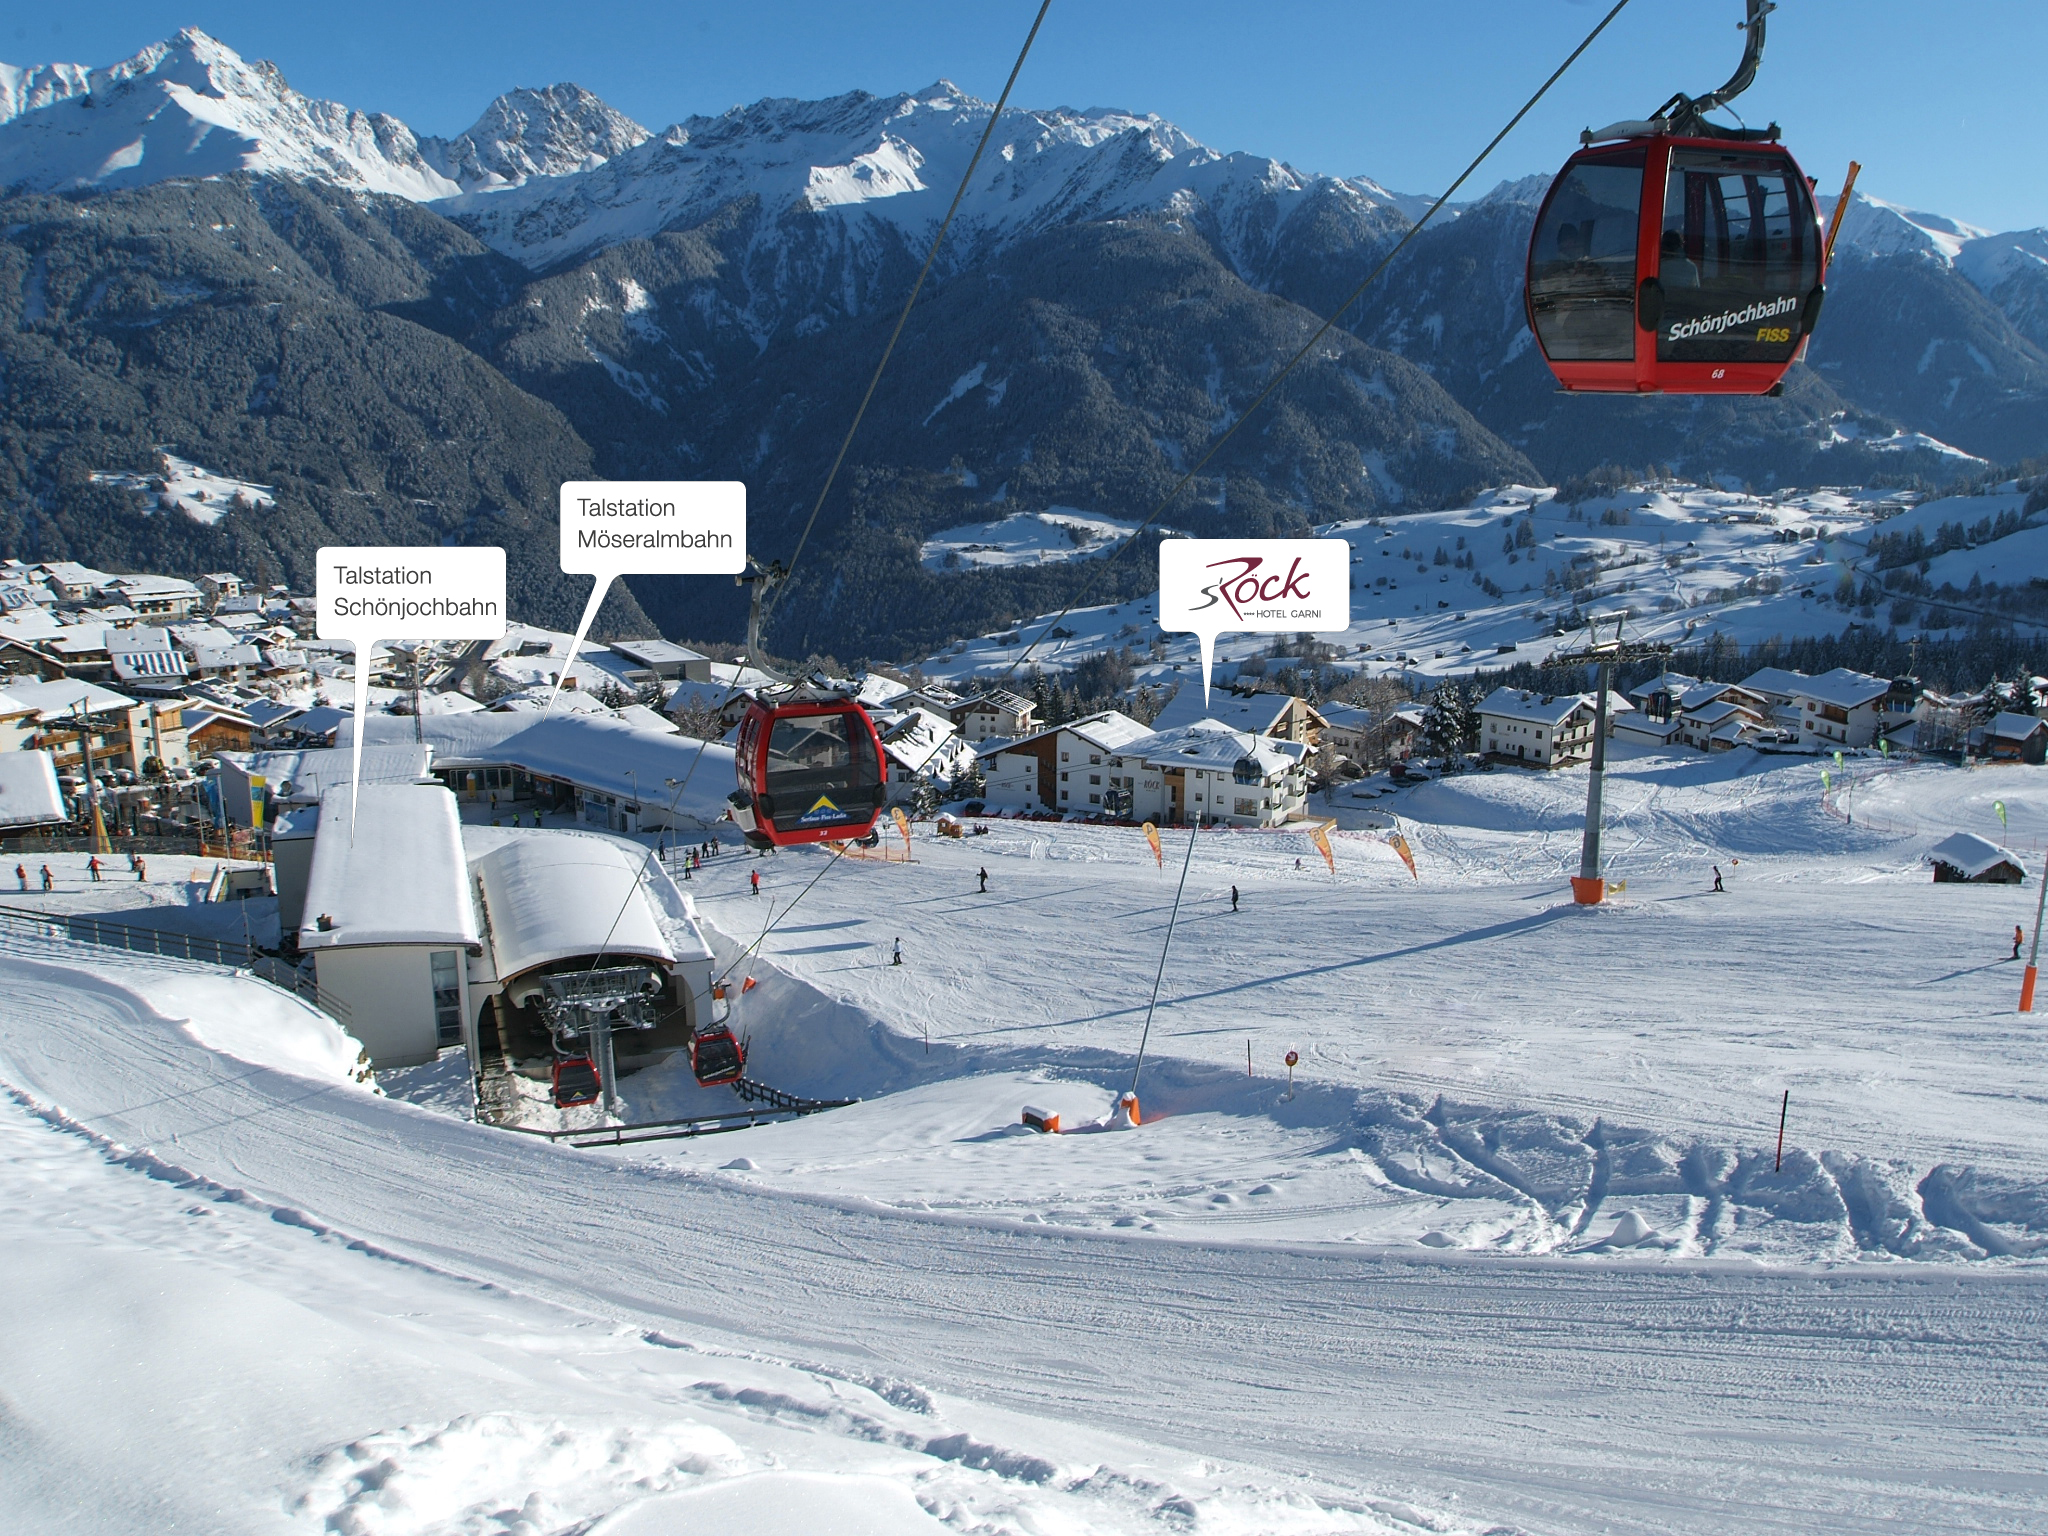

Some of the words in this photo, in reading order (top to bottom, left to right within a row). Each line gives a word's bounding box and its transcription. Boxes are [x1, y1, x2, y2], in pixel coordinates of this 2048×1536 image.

[1668, 296, 1797, 341] Schönjochbahn
[1756, 328, 1791, 342] FISS
[1711, 369, 1725, 379] 68
